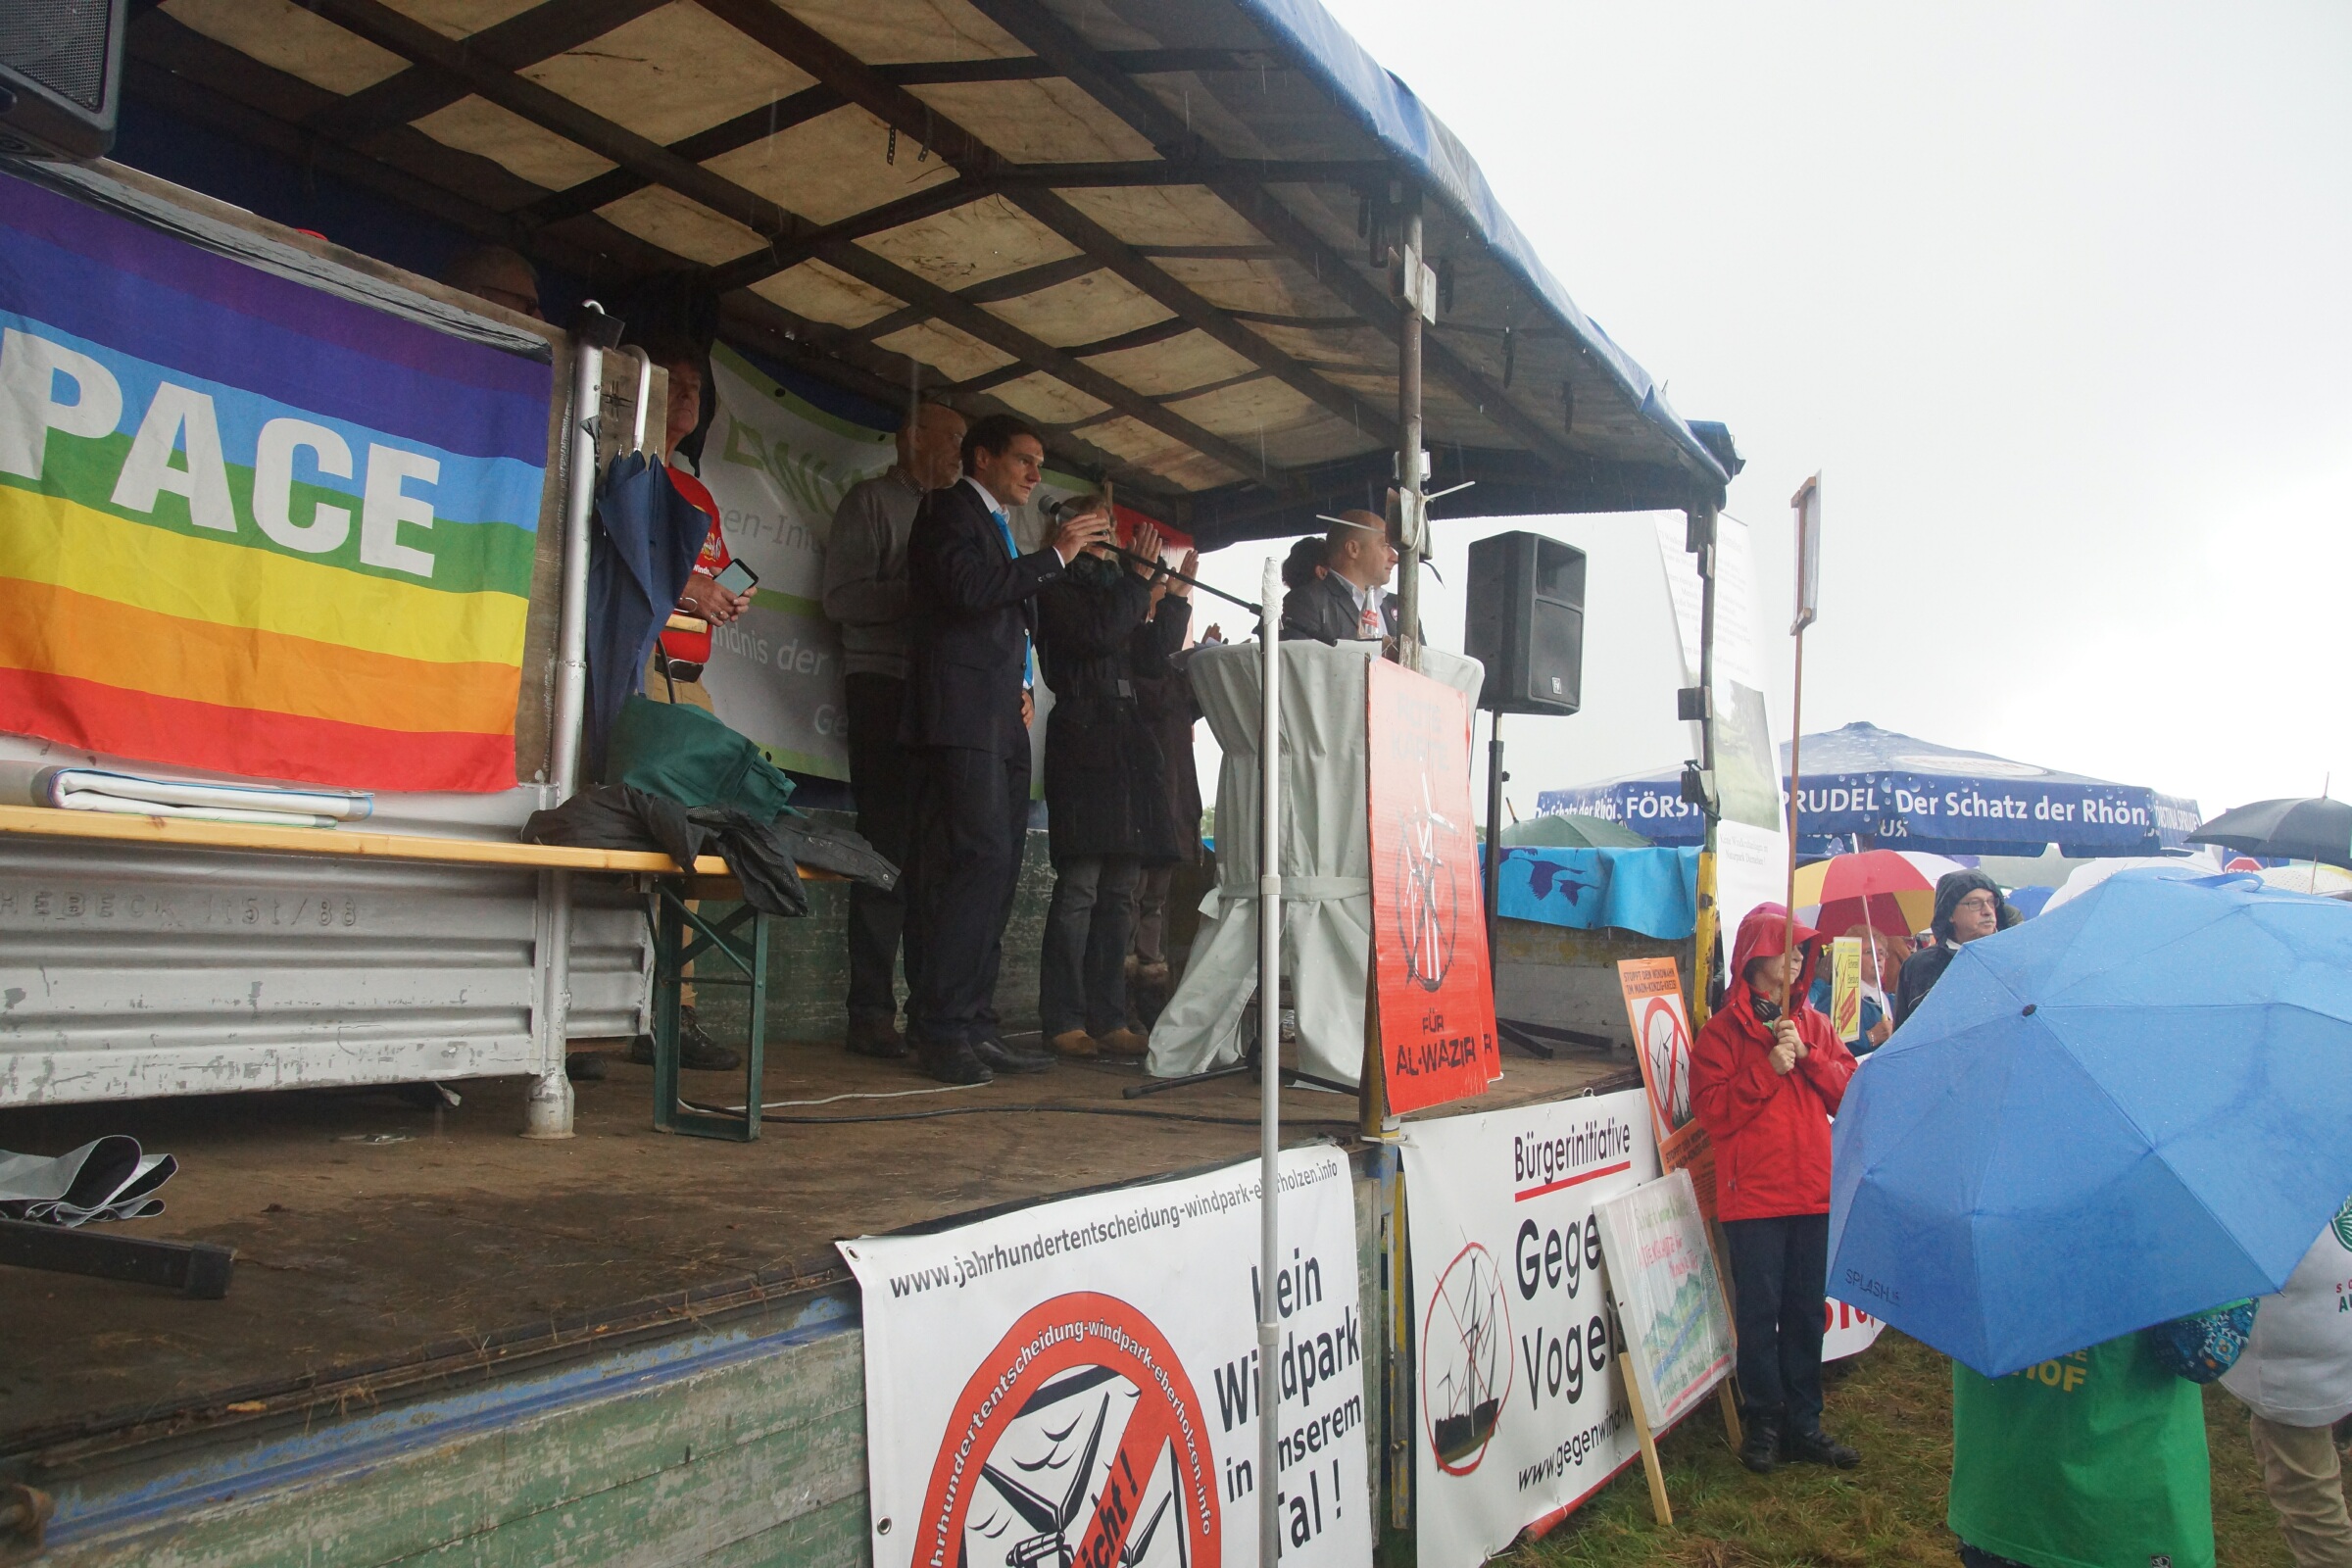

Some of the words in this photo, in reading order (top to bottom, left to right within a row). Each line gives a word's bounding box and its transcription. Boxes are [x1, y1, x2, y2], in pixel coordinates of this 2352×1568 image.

[0, 327, 441, 578] PACE
[777, 638, 829, 675] der
[1396, 690, 1443, 733] ROTE
[1391, 728, 1449, 772] KARTE
[1895, 790, 1938, 815] Der
[1945, 791, 2027, 819] Schatz
[2034, 795, 2075, 823] der
[1624, 970, 1642, 982] STOPPT
[1422, 1007, 1445, 1035] FÜR
[1514, 1116, 1631, 1185] Bürgerinitiative
[890, 1159, 1338, 1298] www.jahrhundertentscheidung-windpark-erholzen.info
[1845, 1268, 1890, 1302] SPLASH
[1214, 1305, 1360, 1433] Widpark
[1226, 1456, 1253, 1503] in
[1277, 1394, 1361, 1472] nserem
